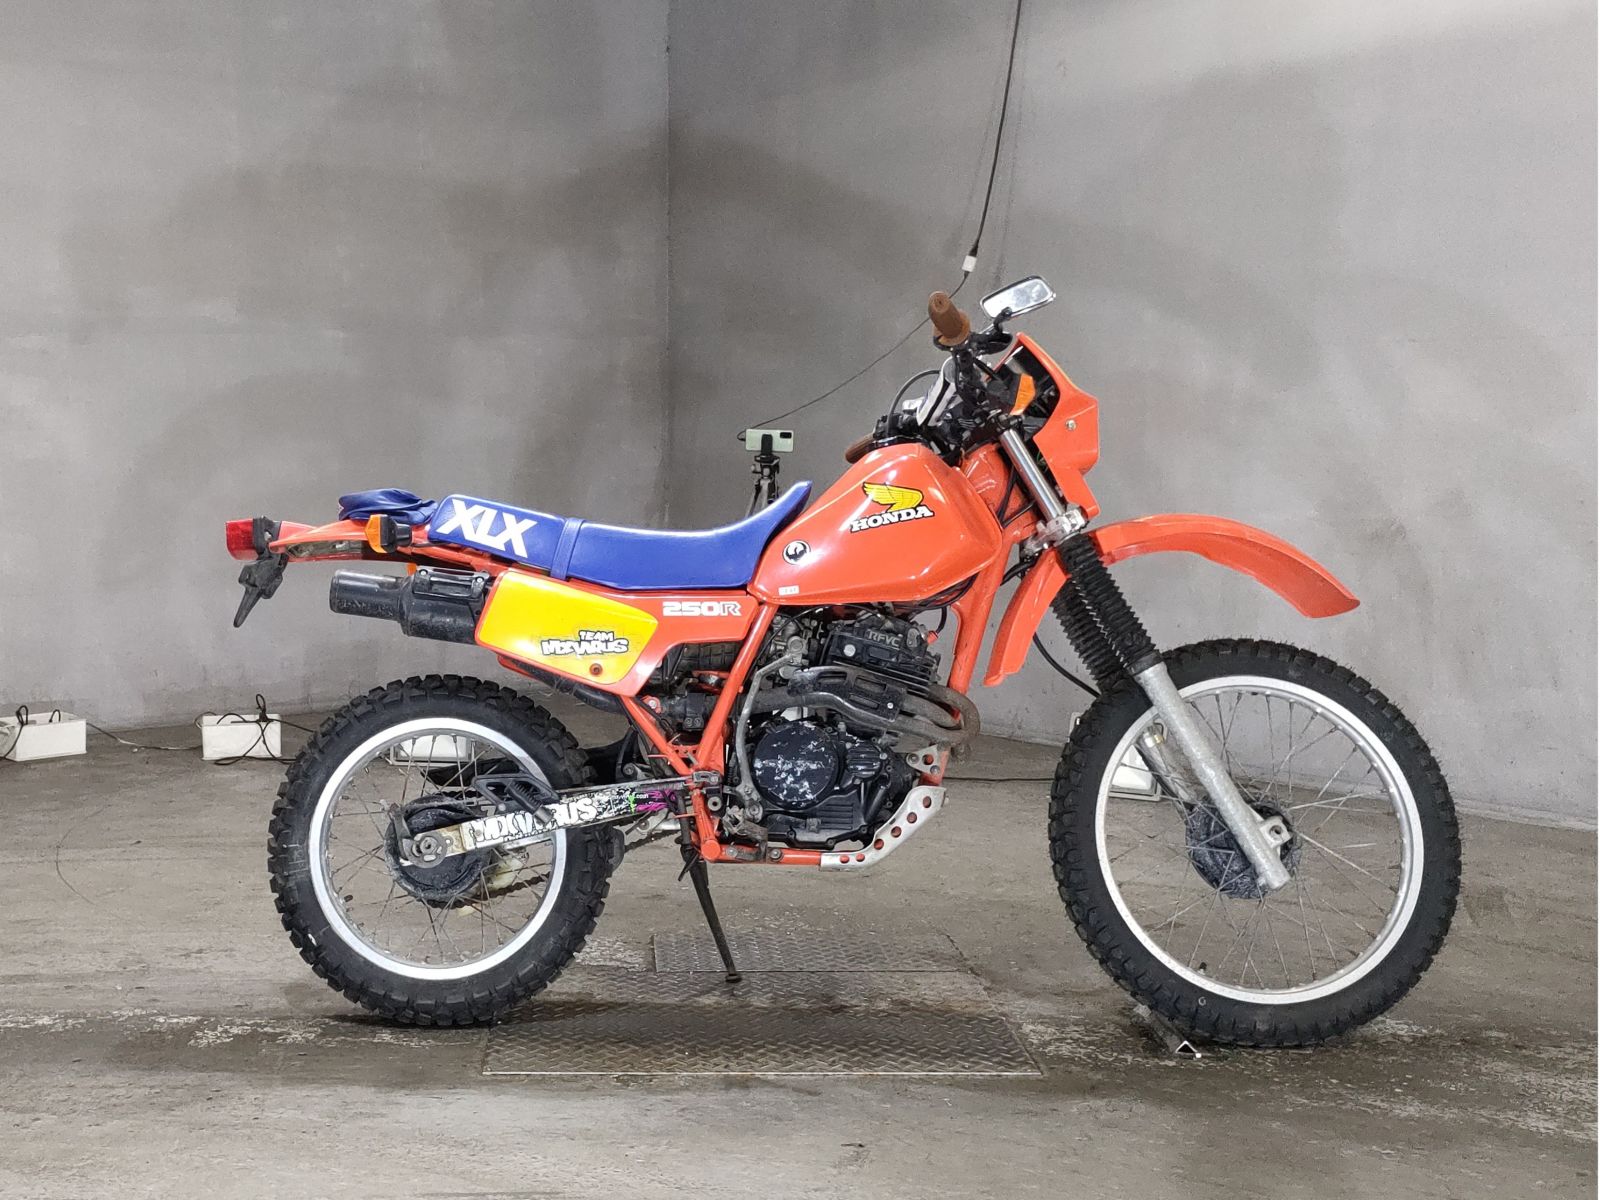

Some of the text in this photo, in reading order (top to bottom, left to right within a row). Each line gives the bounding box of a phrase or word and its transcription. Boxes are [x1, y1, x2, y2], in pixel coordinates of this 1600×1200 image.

[850, 506, 934, 532] HONDA
[437, 499, 538, 558] XLX
[663, 601, 742, 616] 250R
[579, 630, 614, 641] TEAM
[867, 630, 901, 647] RFVC
